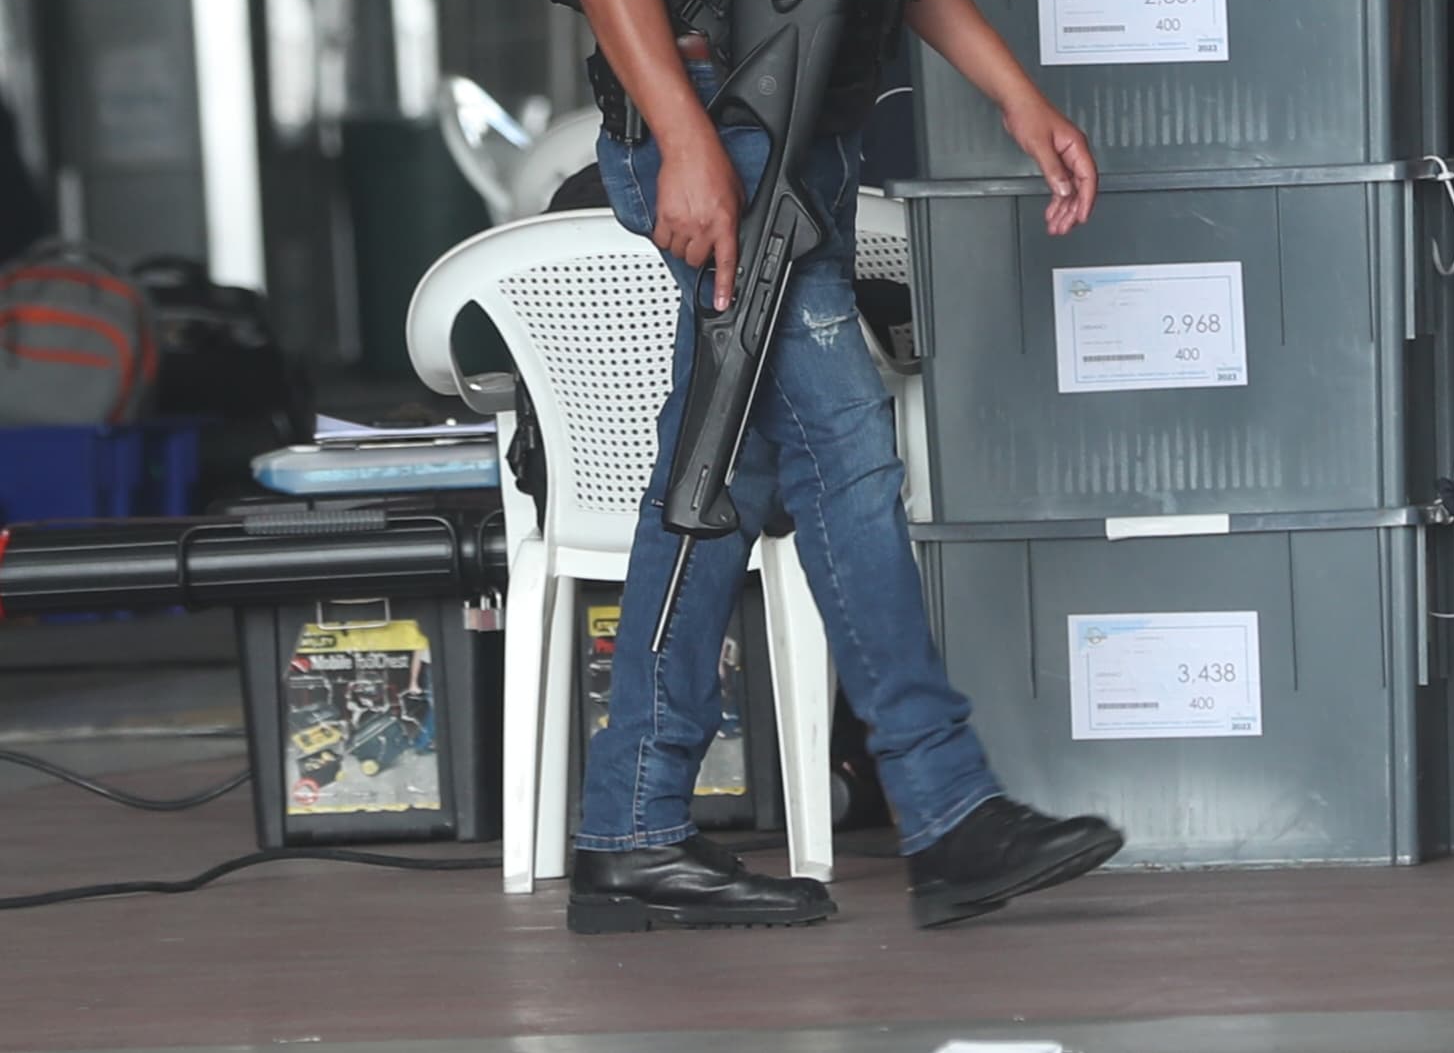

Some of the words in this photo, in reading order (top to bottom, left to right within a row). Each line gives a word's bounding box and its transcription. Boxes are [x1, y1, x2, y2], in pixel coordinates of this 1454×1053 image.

[1155, 17, 1181, 31] 400
[1162, 313, 1222, 335] 2,968
[1175, 347, 1200, 361] 400
[1177, 662, 1236, 684] 3,438
[1189, 696, 1215, 710] 400
